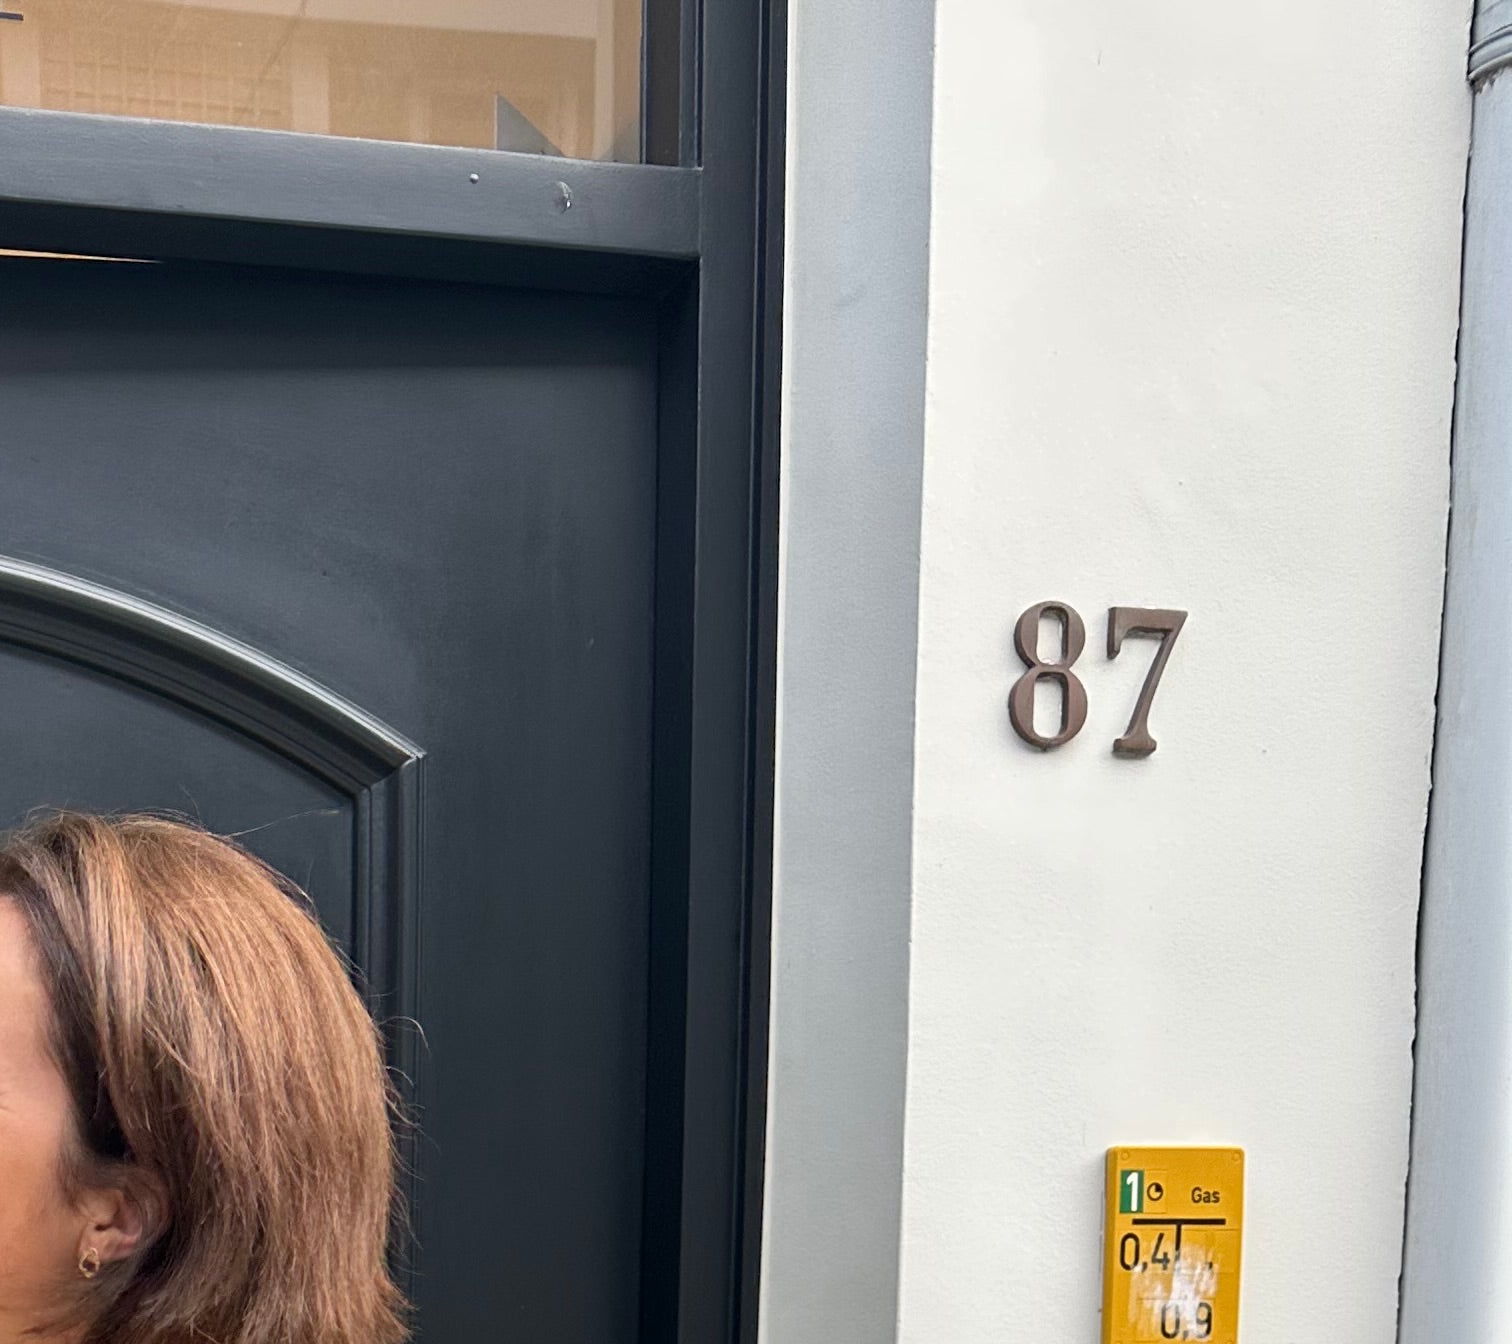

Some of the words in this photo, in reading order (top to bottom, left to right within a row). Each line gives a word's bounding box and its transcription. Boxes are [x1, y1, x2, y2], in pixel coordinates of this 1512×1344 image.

[1008, 600, 1188, 759] 87
[1125, 1171, 1139, 1212] 1
[1191, 1187, 1221, 1204] Gas
[1119, 1232, 1171, 1273] 0,4
[1160, 1302, 1213, 1341] 0,9
